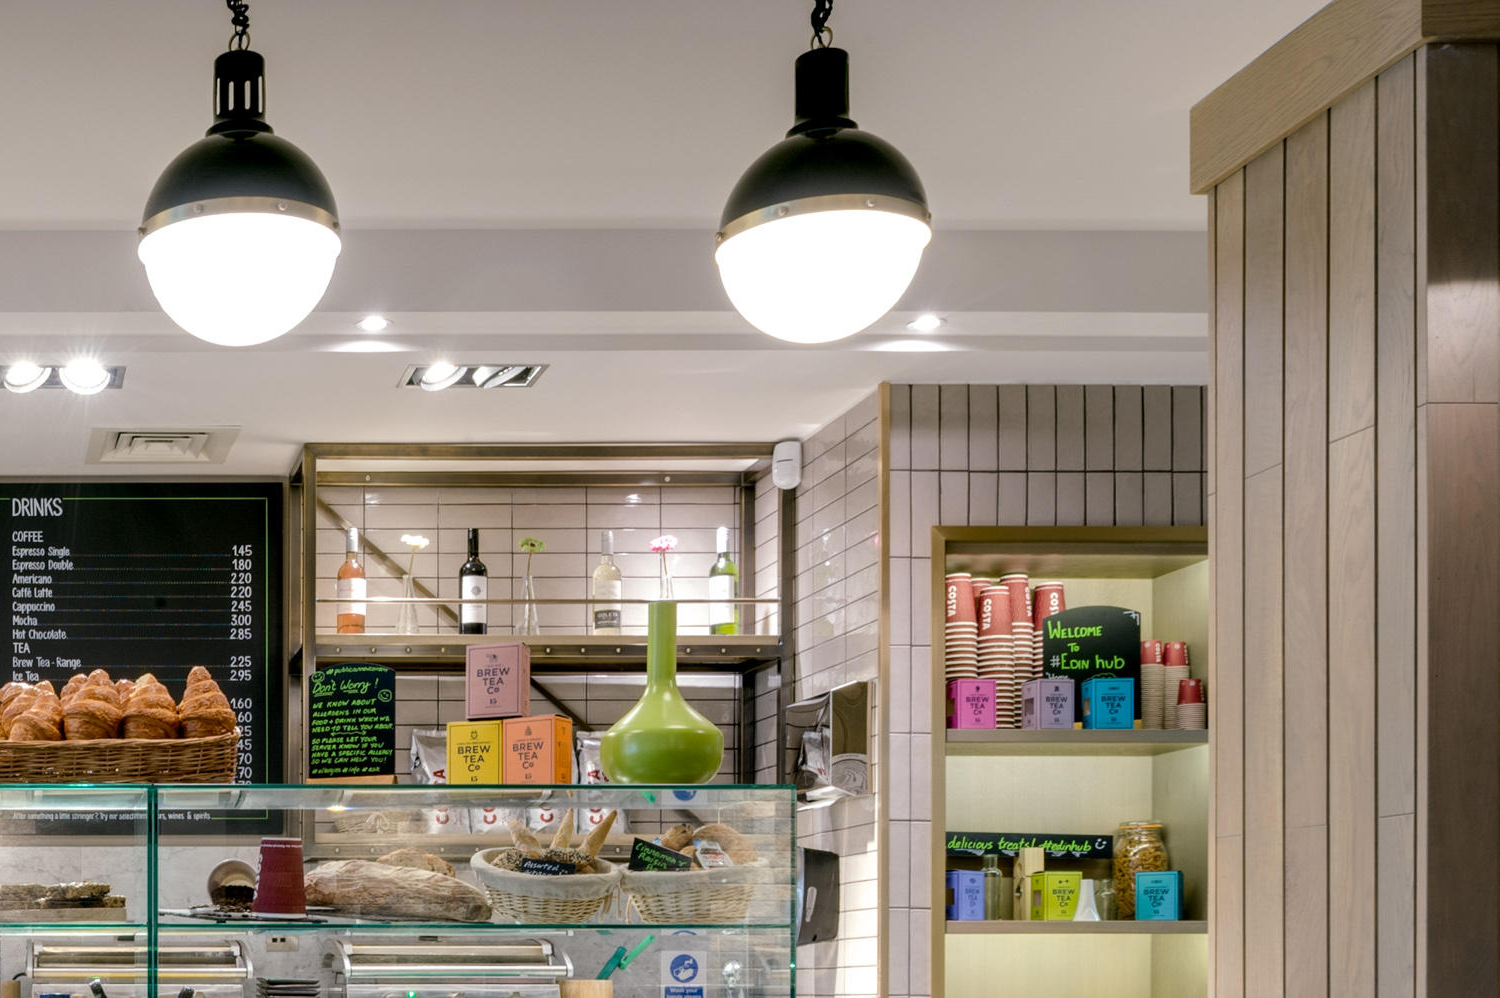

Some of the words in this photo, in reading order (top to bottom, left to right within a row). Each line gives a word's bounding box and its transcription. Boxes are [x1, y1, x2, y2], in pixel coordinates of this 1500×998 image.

[12, 498, 63, 516] DRINKS
[12, 531, 43, 542] COFFEE
[12, 547, 45, 558] Espresso
[48, 547, 70, 558] Single
[12, 560, 45, 571] Espresso
[12, 574, 52, 584] Americano
[34, 587, 52, 597] Latte
[947, 585, 956, 617] COSTA
[12, 602, 55, 614] Cappuccino
[982, 598, 992, 630] COSTA
[12, 616, 37, 626] Mocha
[12, 630, 26, 640] Hot
[28, 630, 66, 640] Chocolate
[13, 643, 30, 654] TEA
[12, 657, 33, 667] Brew
[1095, 655, 1125, 669] hub
[25, 671, 39, 682] Tea
[477, 667, 510, 677] BREW
[483, 677, 504, 686] TEA
[458, 745, 490, 754] BREW
[513, 742, 544, 751] BREW
[464, 755, 484, 763] TEA
[518, 752, 538, 760] TEA
[948, 835, 993, 849] delicious
